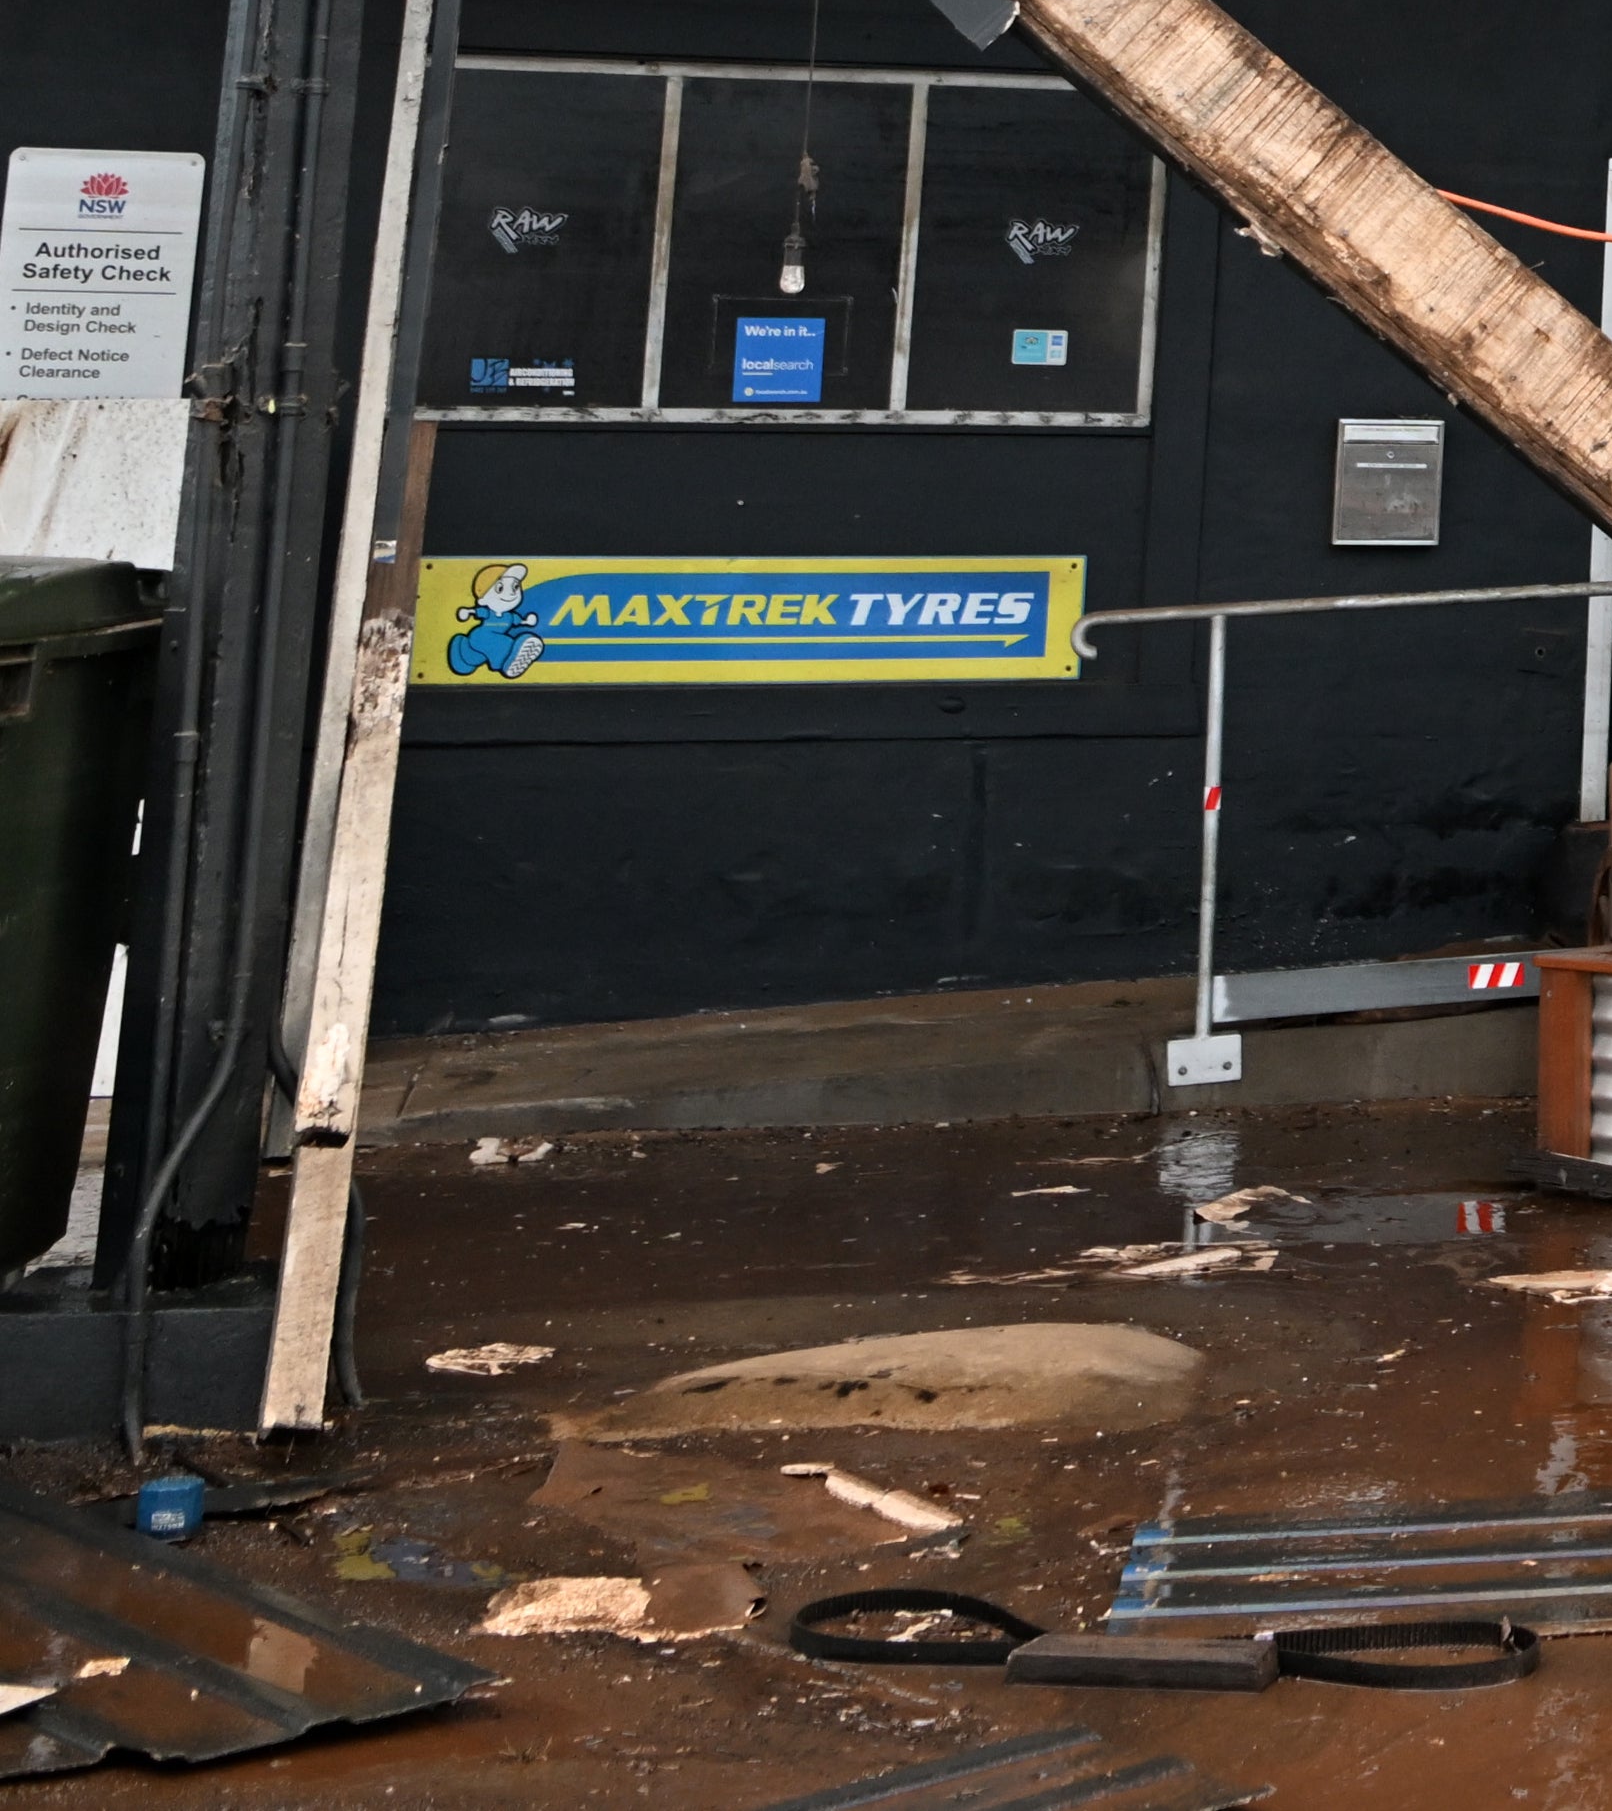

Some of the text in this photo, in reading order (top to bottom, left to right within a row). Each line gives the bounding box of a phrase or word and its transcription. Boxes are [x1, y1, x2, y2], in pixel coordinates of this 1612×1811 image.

[78, 198, 127, 214] NSW
[490, 208, 566, 242] RAW
[1007, 221, 1077, 253] RAW
[34, 242, 161, 261] Authorised
[22, 263, 171, 284] Safety Check
[25, 302, 121, 319] Identity and
[24, 319, 137, 335] Design Check
[744, 325, 781, 337] We're
[784, 326, 796, 337] in
[21, 347, 130, 363] Defect Notice
[742, 357, 814, 370] localsearch
[19, 365, 101, 379] Clearance
[548, 592, 1035, 627] MAXTREK TYRES
